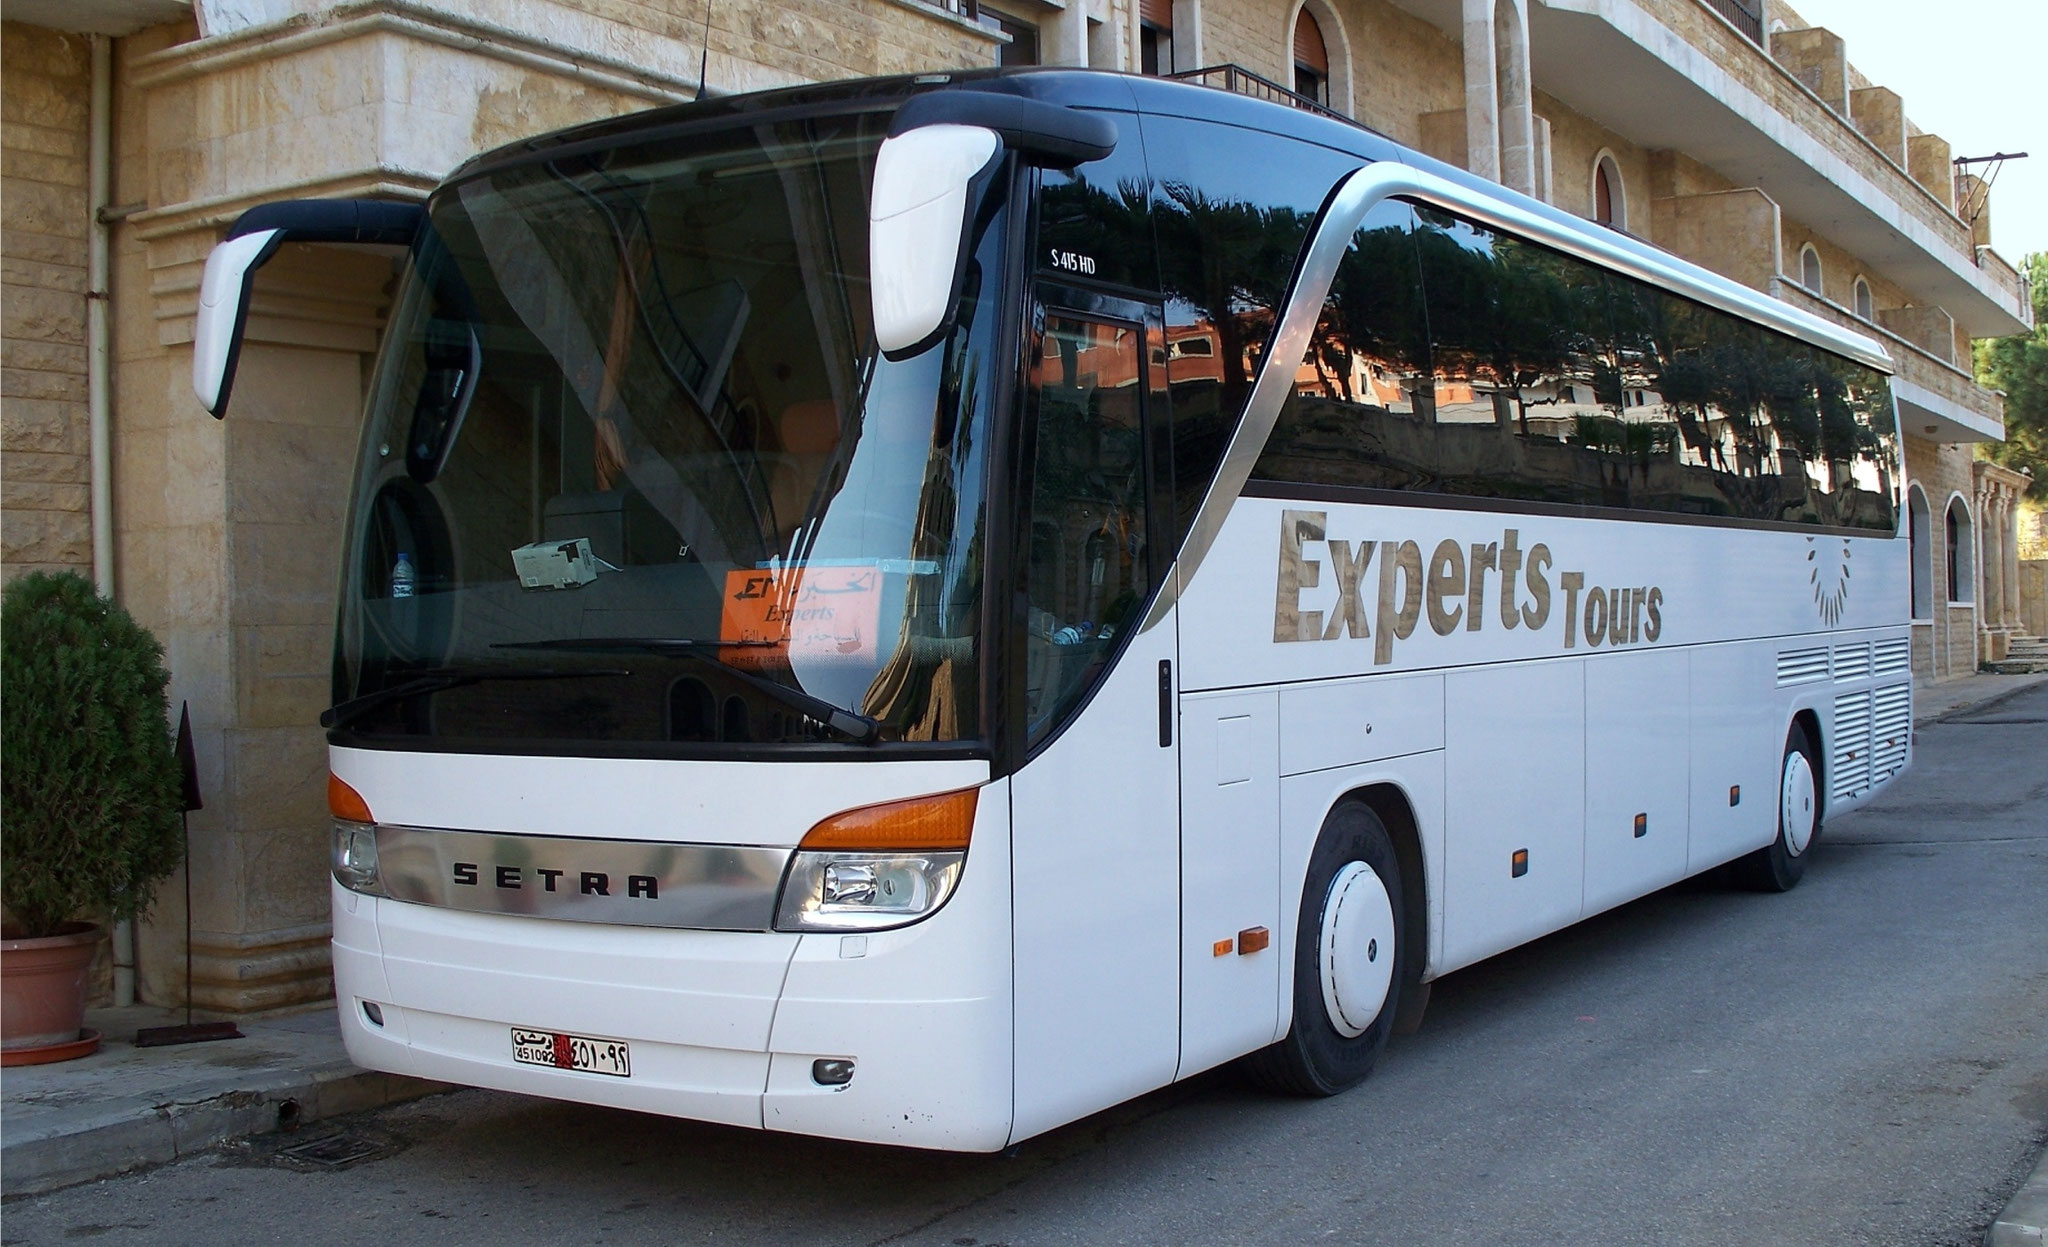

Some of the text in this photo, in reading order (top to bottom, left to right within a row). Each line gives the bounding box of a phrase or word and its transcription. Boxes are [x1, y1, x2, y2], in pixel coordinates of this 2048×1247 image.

[1050, 248, 1096, 275] S 415 HD
[1273, 509, 1664, 665] Experts Tours
[763, 605, 836, 625] Experts
[453, 862, 659, 900] SETRA
